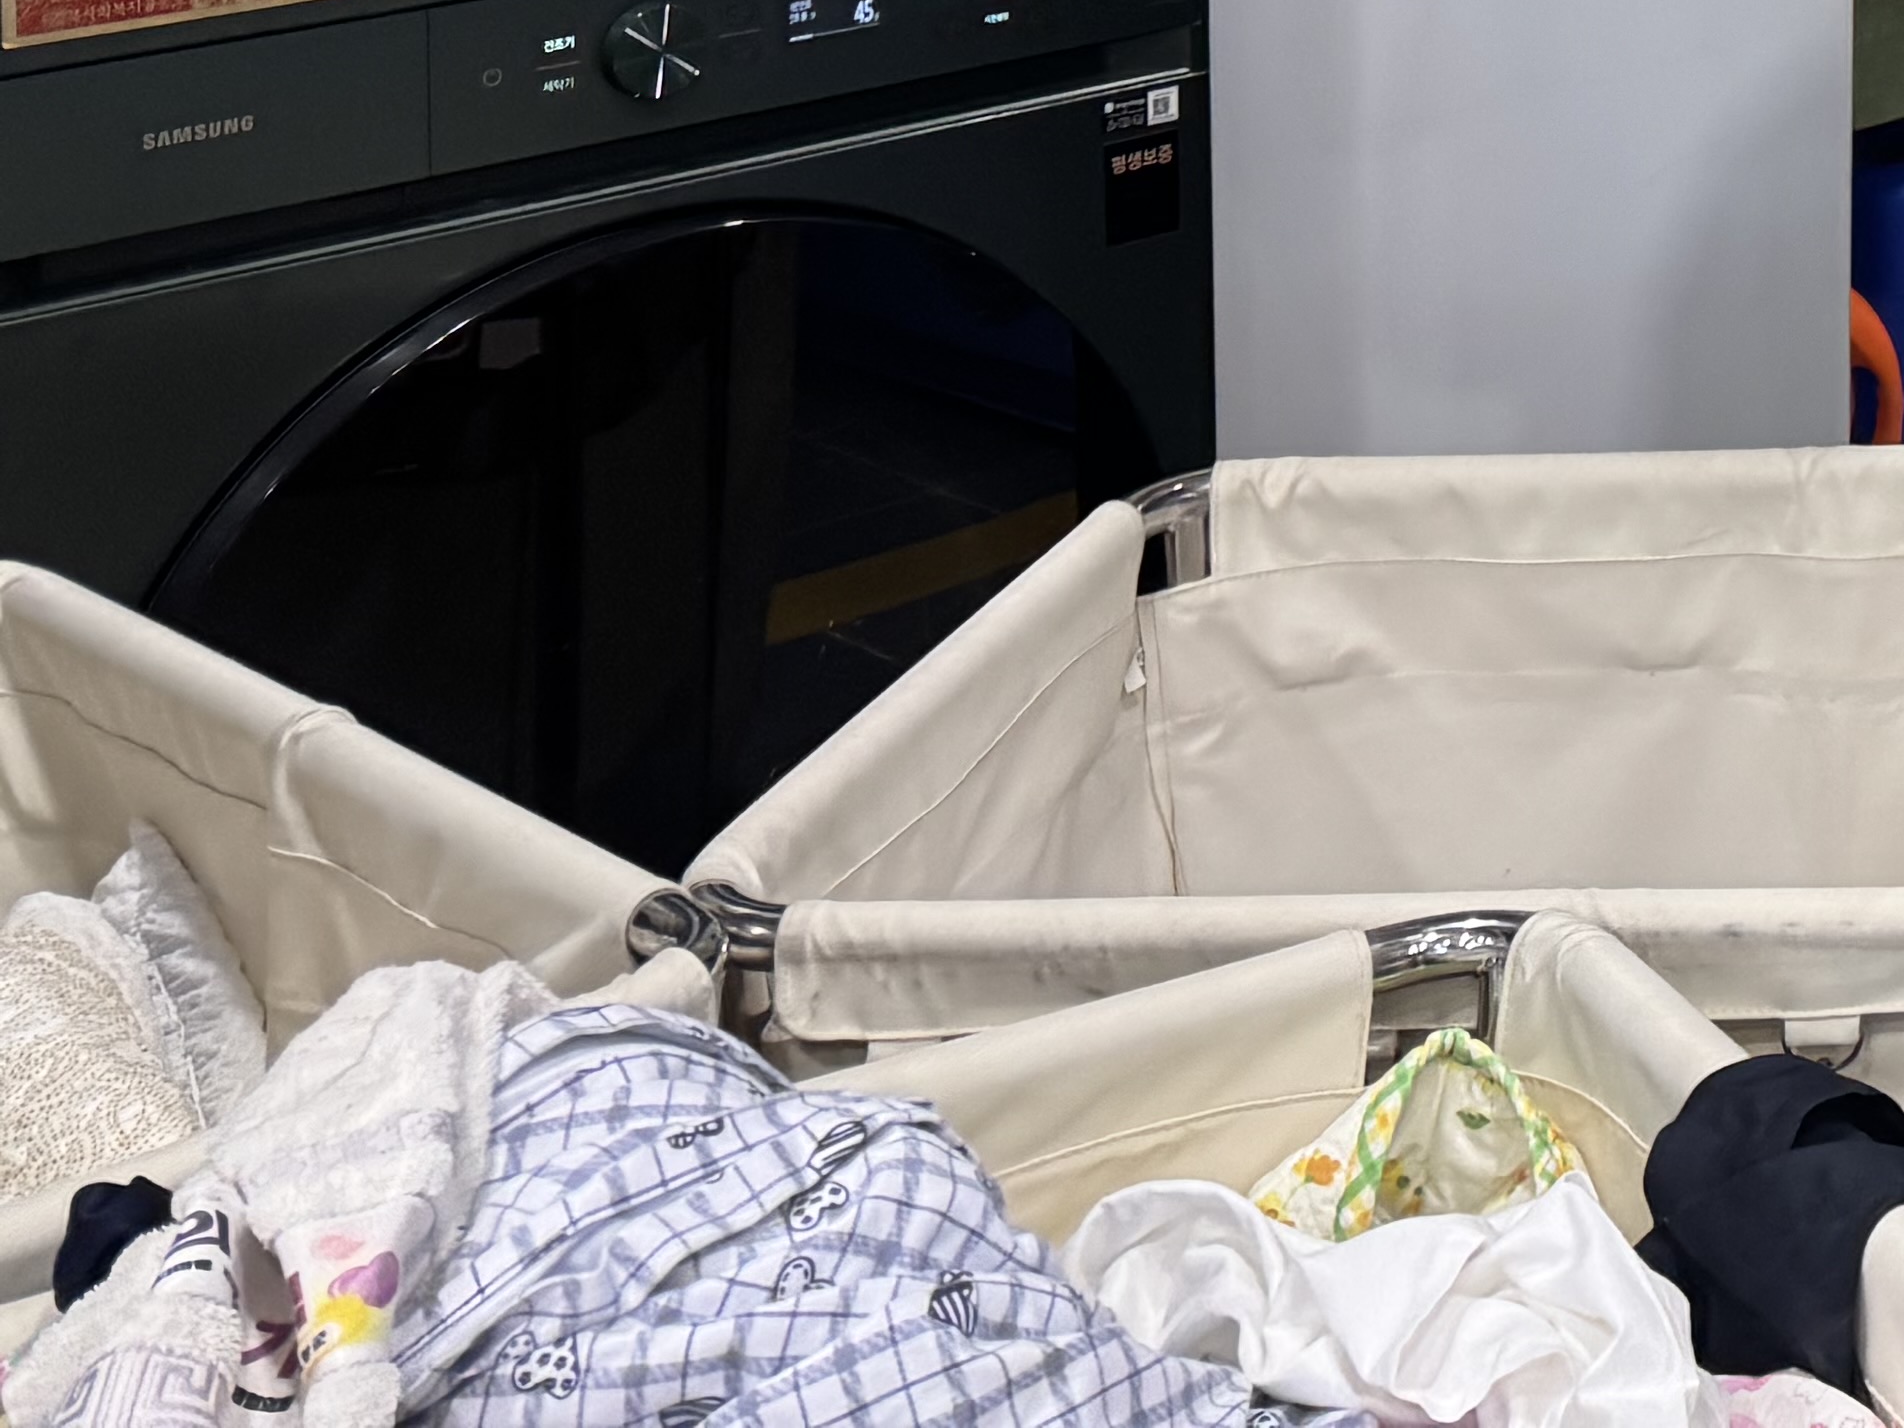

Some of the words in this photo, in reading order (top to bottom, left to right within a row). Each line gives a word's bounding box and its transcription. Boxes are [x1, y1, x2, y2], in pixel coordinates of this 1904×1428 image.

[542, 34, 576, 53] 건조기
[542, 76, 576, 95] 세탁기
[143, 114, 255, 151] SAMSUNG
[1111, 143, 1174, 176] 평생보증
